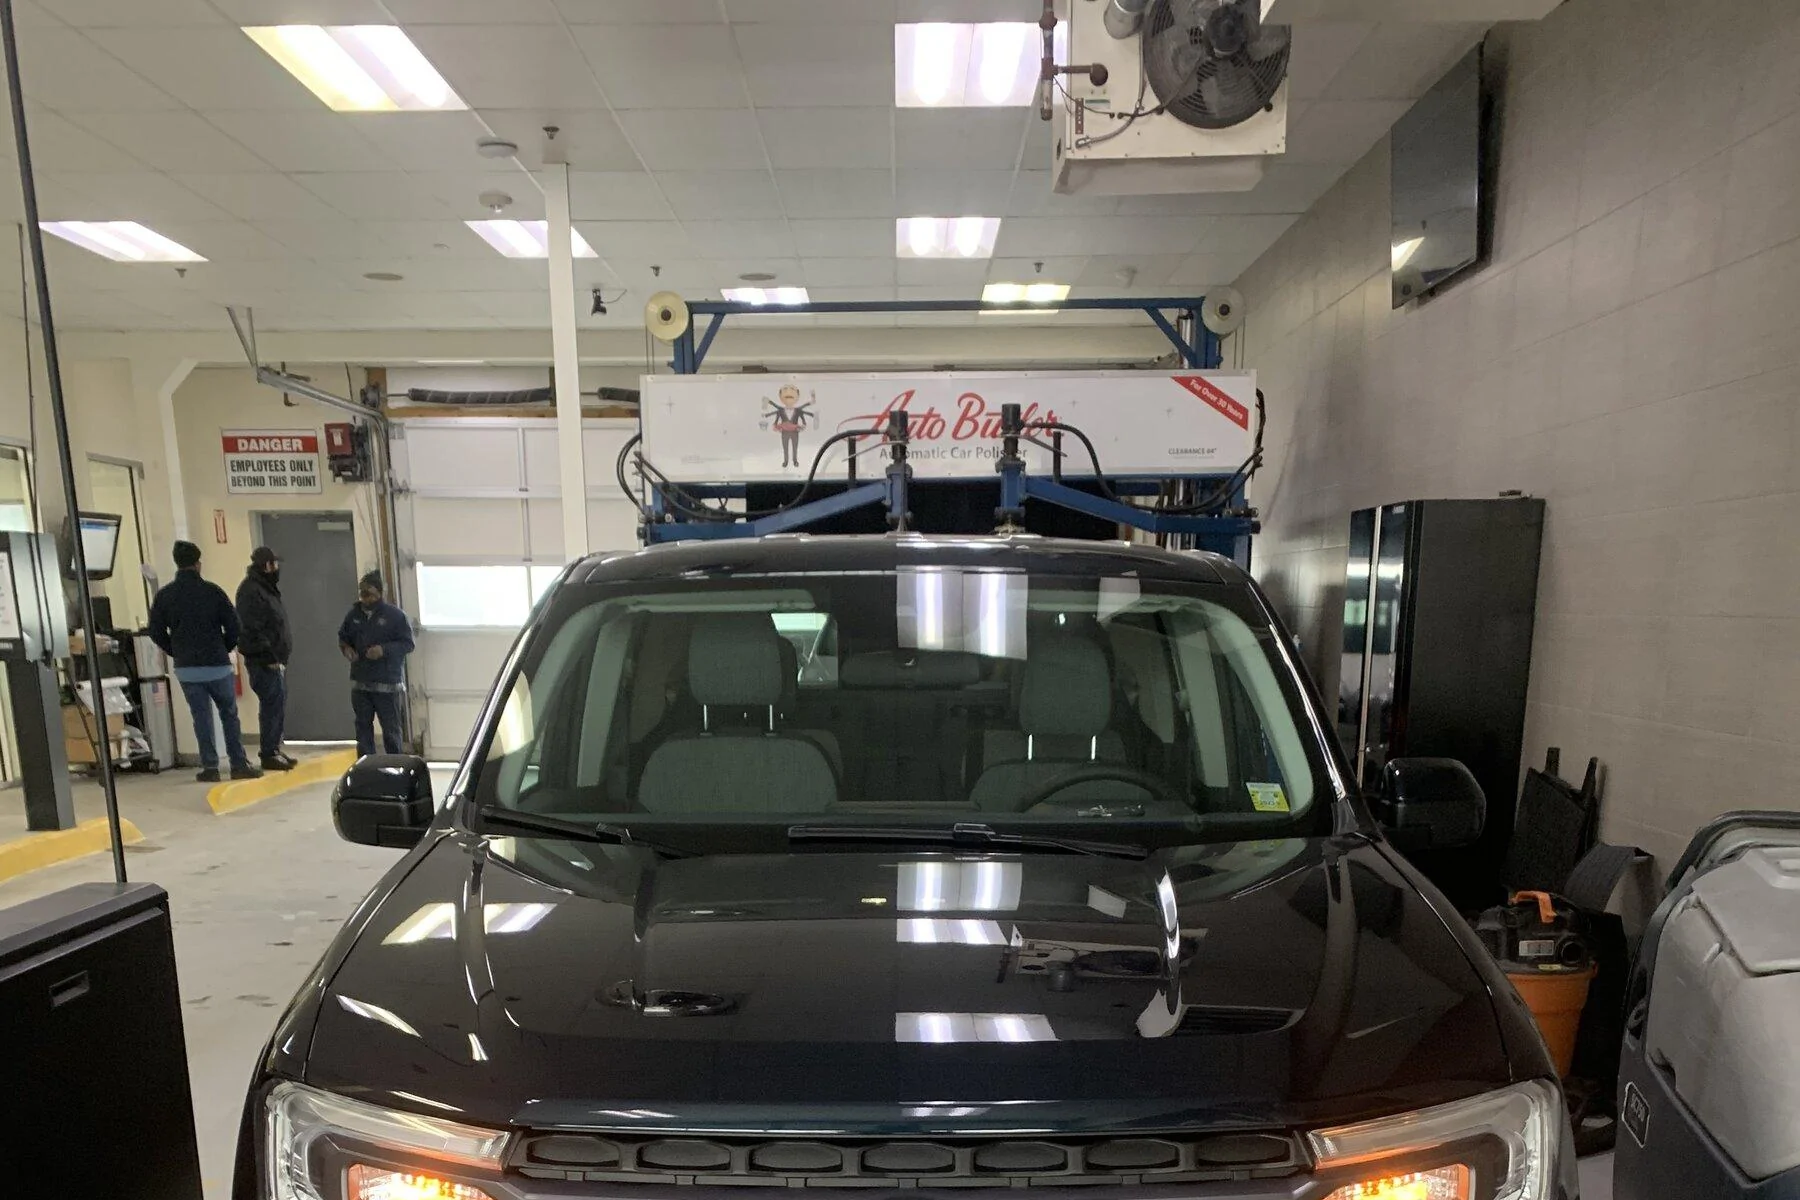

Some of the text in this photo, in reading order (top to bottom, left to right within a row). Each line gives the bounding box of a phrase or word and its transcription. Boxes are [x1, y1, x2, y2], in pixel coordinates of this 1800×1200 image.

[1201, 387, 1218, 402] Over
[1226, 403, 1243, 420] Years
[951, 392, 1064, 441] Buler
[237, 438, 303, 451] DANGER
[1168, 447, 1205, 455] CLEARANCE
[950, 447, 973, 460] Car
[976, 446, 1028, 459] Poliser
[230, 459, 314, 472] EMPLOYEES ONLY
[231, 475, 316, 487] BEYOND THIS POINT
